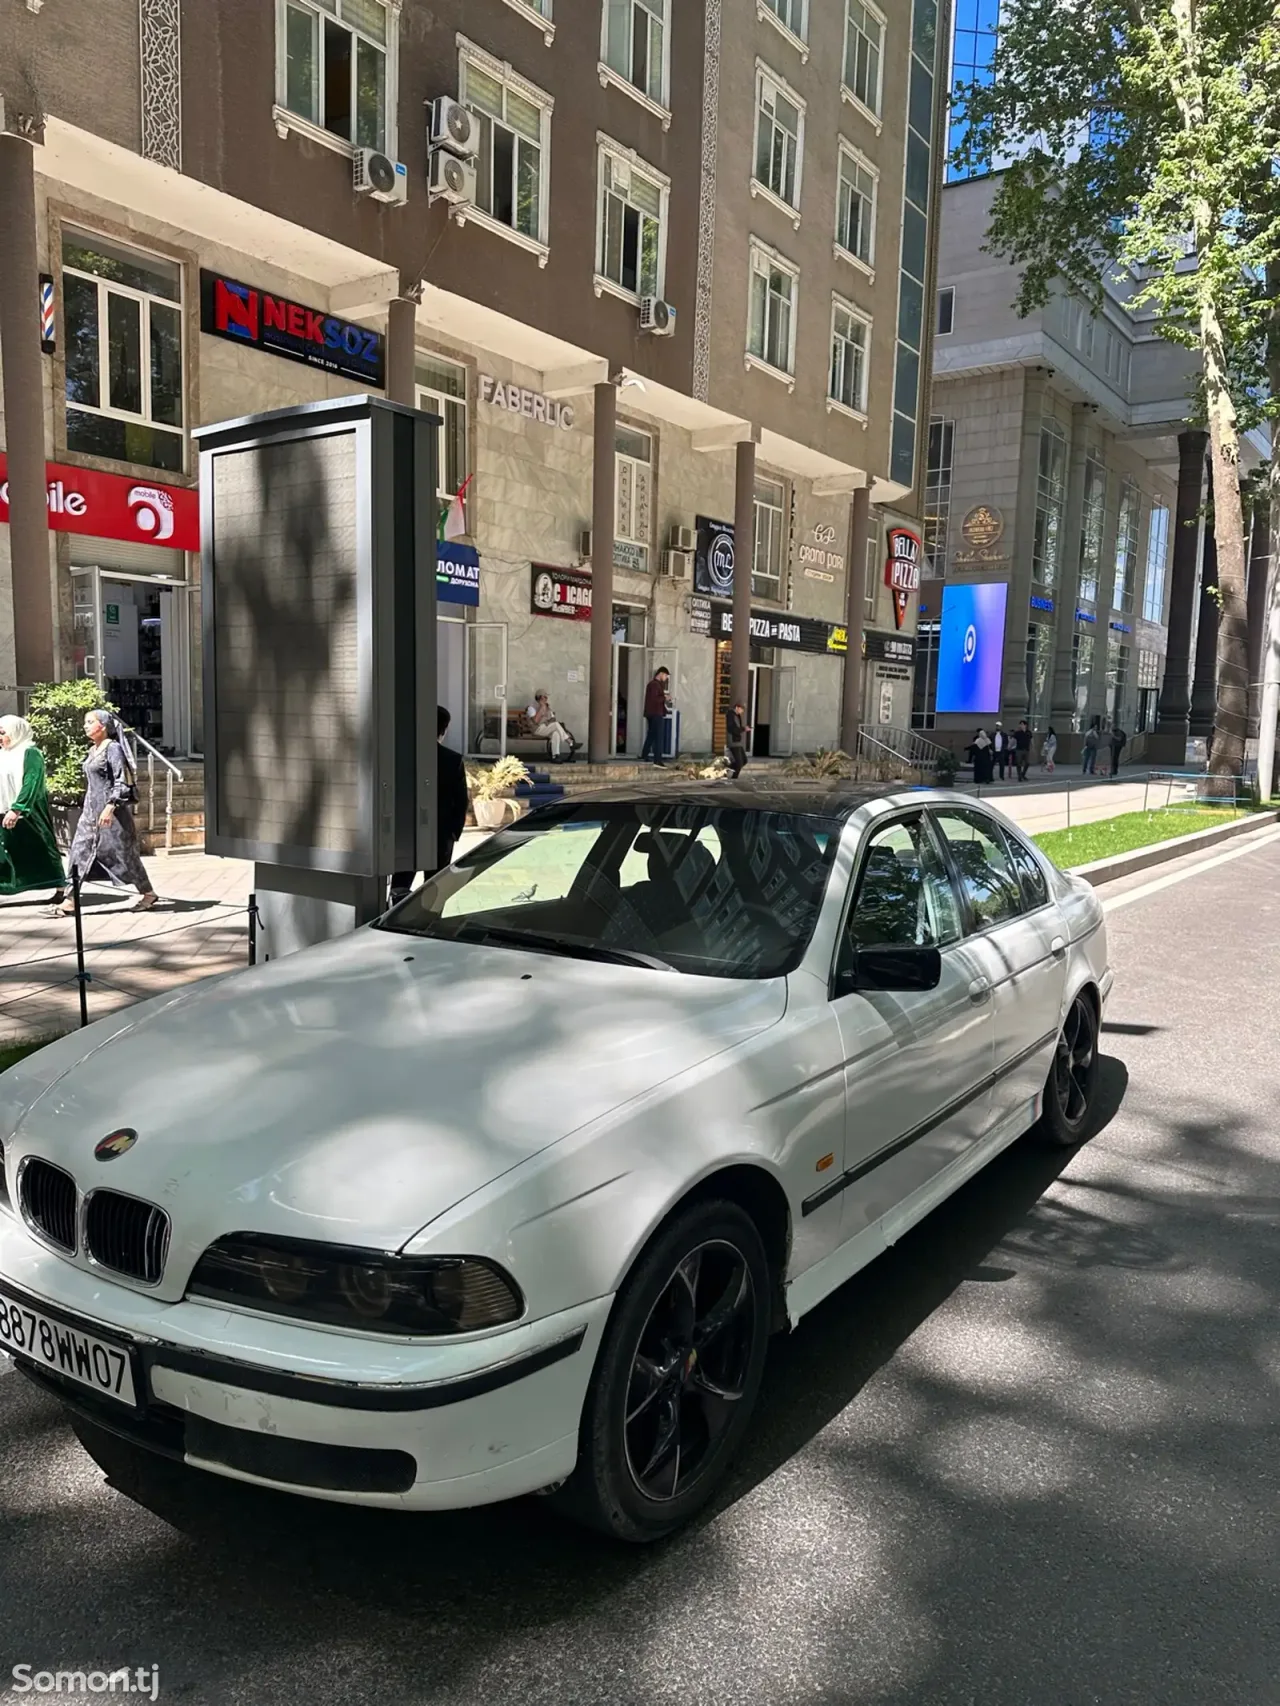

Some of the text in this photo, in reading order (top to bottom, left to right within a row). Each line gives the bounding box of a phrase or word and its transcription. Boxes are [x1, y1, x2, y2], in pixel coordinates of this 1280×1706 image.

[263, 295, 379, 363] NEKSOZ
[308, 354, 325, 366] SINCE
[478, 374, 574, 432] FABERLIC
[134, 489, 157, 500] mobile
[894, 536, 917, 562] BELLA
[436, 559, 480, 580] ЛОМАТ
[894, 562, 920, 590] PIZZA
[749, 617, 770, 638] PIZZA
[778, 622, 800, 642] PASTA
